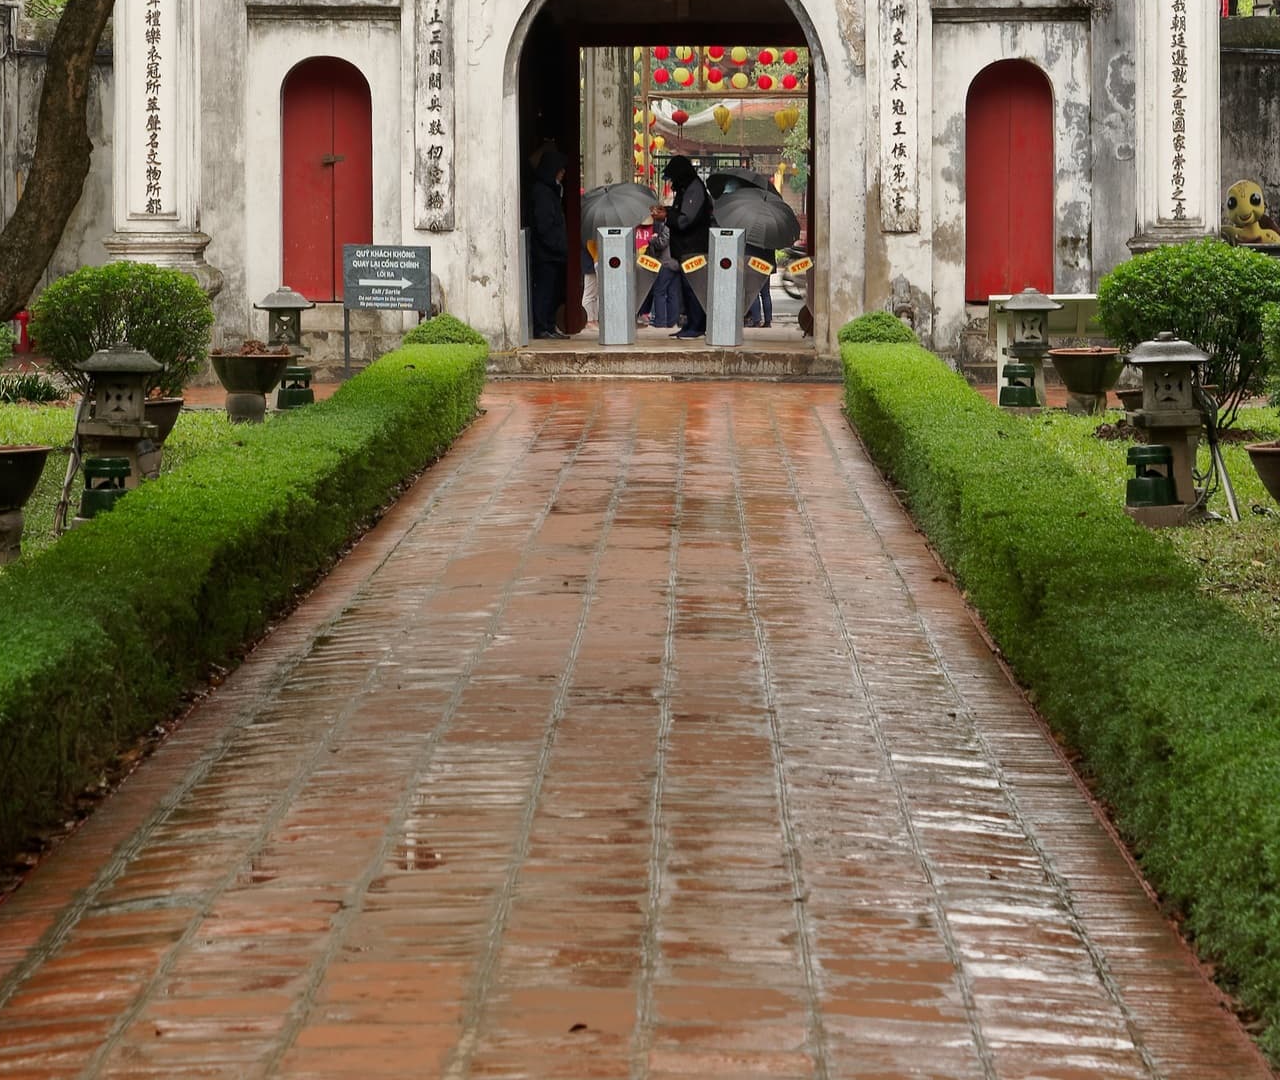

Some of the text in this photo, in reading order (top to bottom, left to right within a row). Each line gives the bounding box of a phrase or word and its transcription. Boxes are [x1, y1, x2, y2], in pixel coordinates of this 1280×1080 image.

[352, 260, 369, 268] QUAY
[640, 256, 659, 270] STOP
[685, 257, 703, 270] STOP
[751, 260, 770, 272] STOP
[791, 260, 810, 272] STOP
